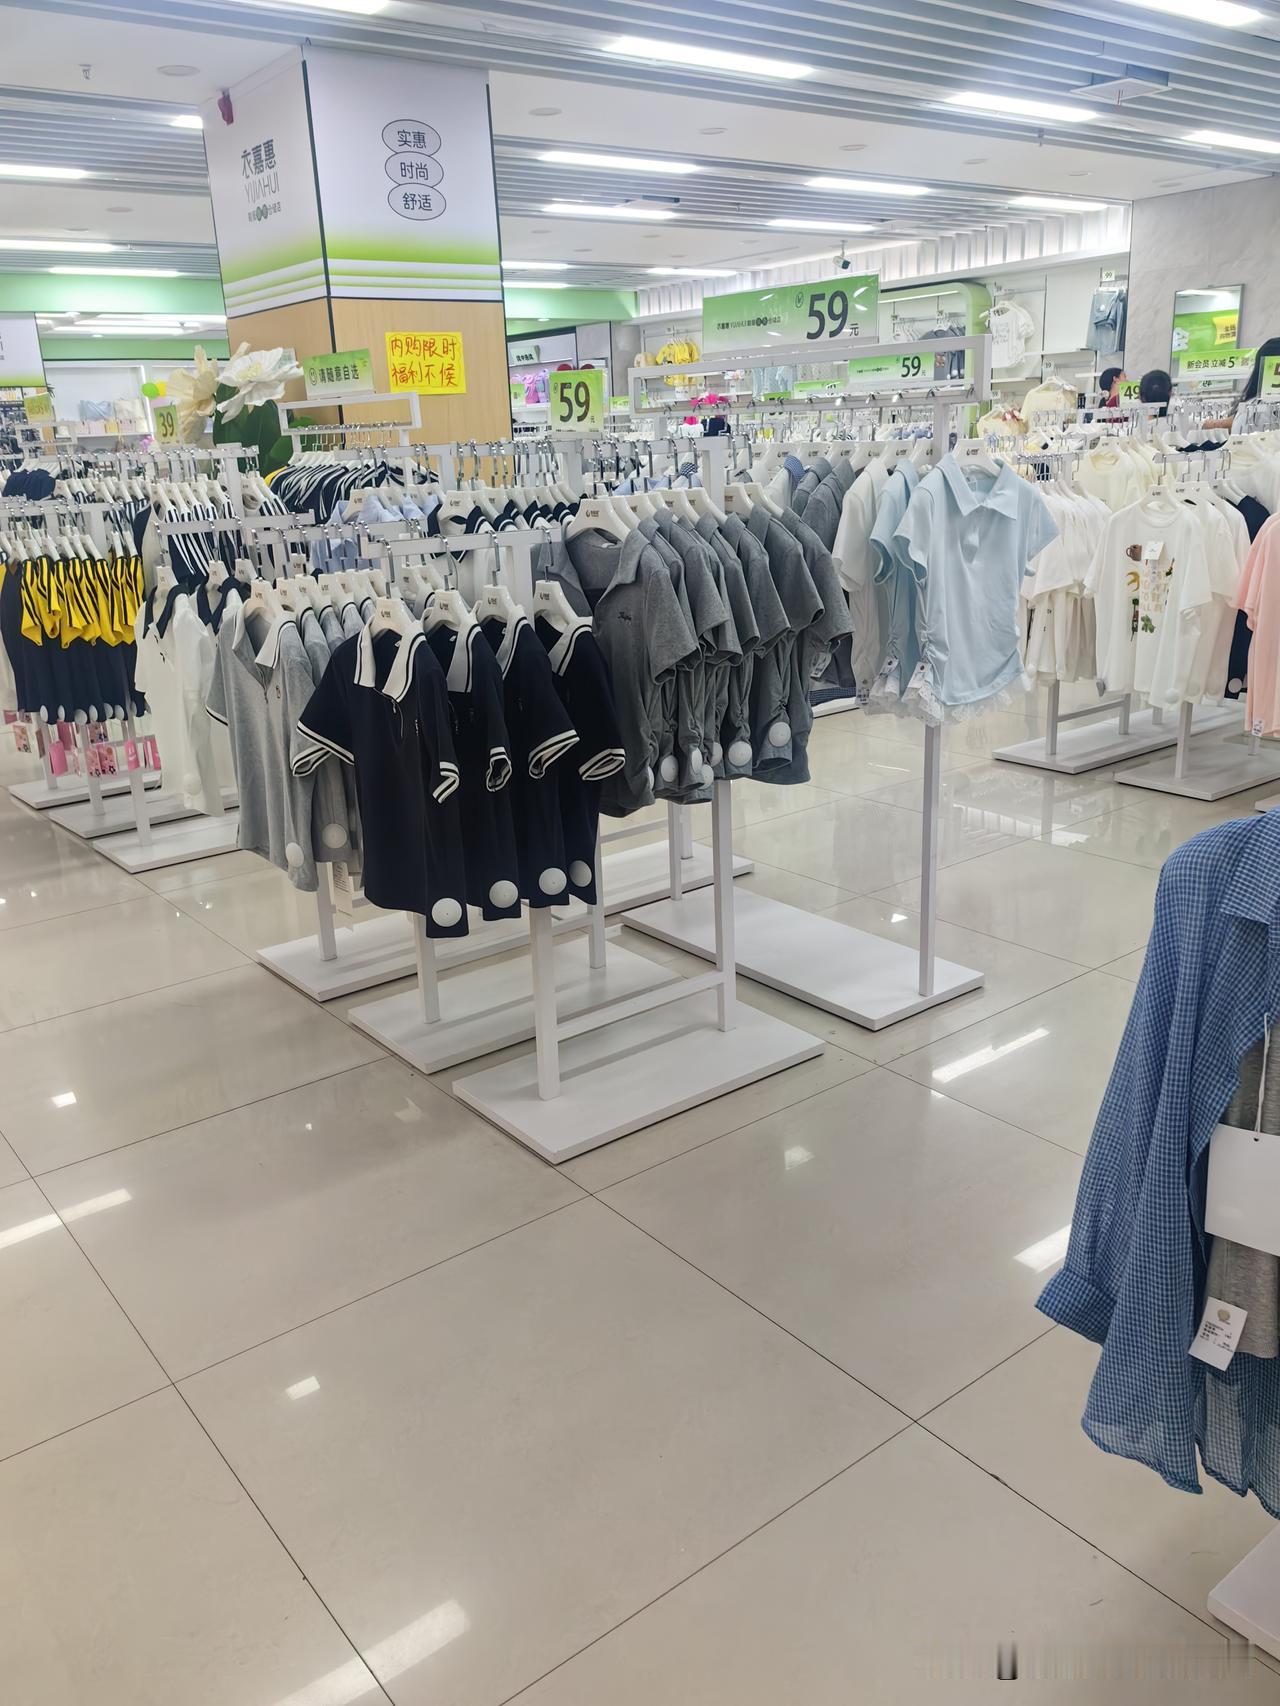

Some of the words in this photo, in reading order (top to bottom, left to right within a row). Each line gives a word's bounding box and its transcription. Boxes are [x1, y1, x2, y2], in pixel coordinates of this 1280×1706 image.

[397, 130, 427, 149] 实惠
[241, 138, 276, 179] 衣嘉惠
[400, 162, 429, 180] 时尚
[402, 193, 433, 211] 舒适
[390, 336, 457, 360] 内购限时
[319, 363, 360, 383] 请随意自选
[391, 363, 458, 388] 福利不候
[159, 411, 174, 437] 39
